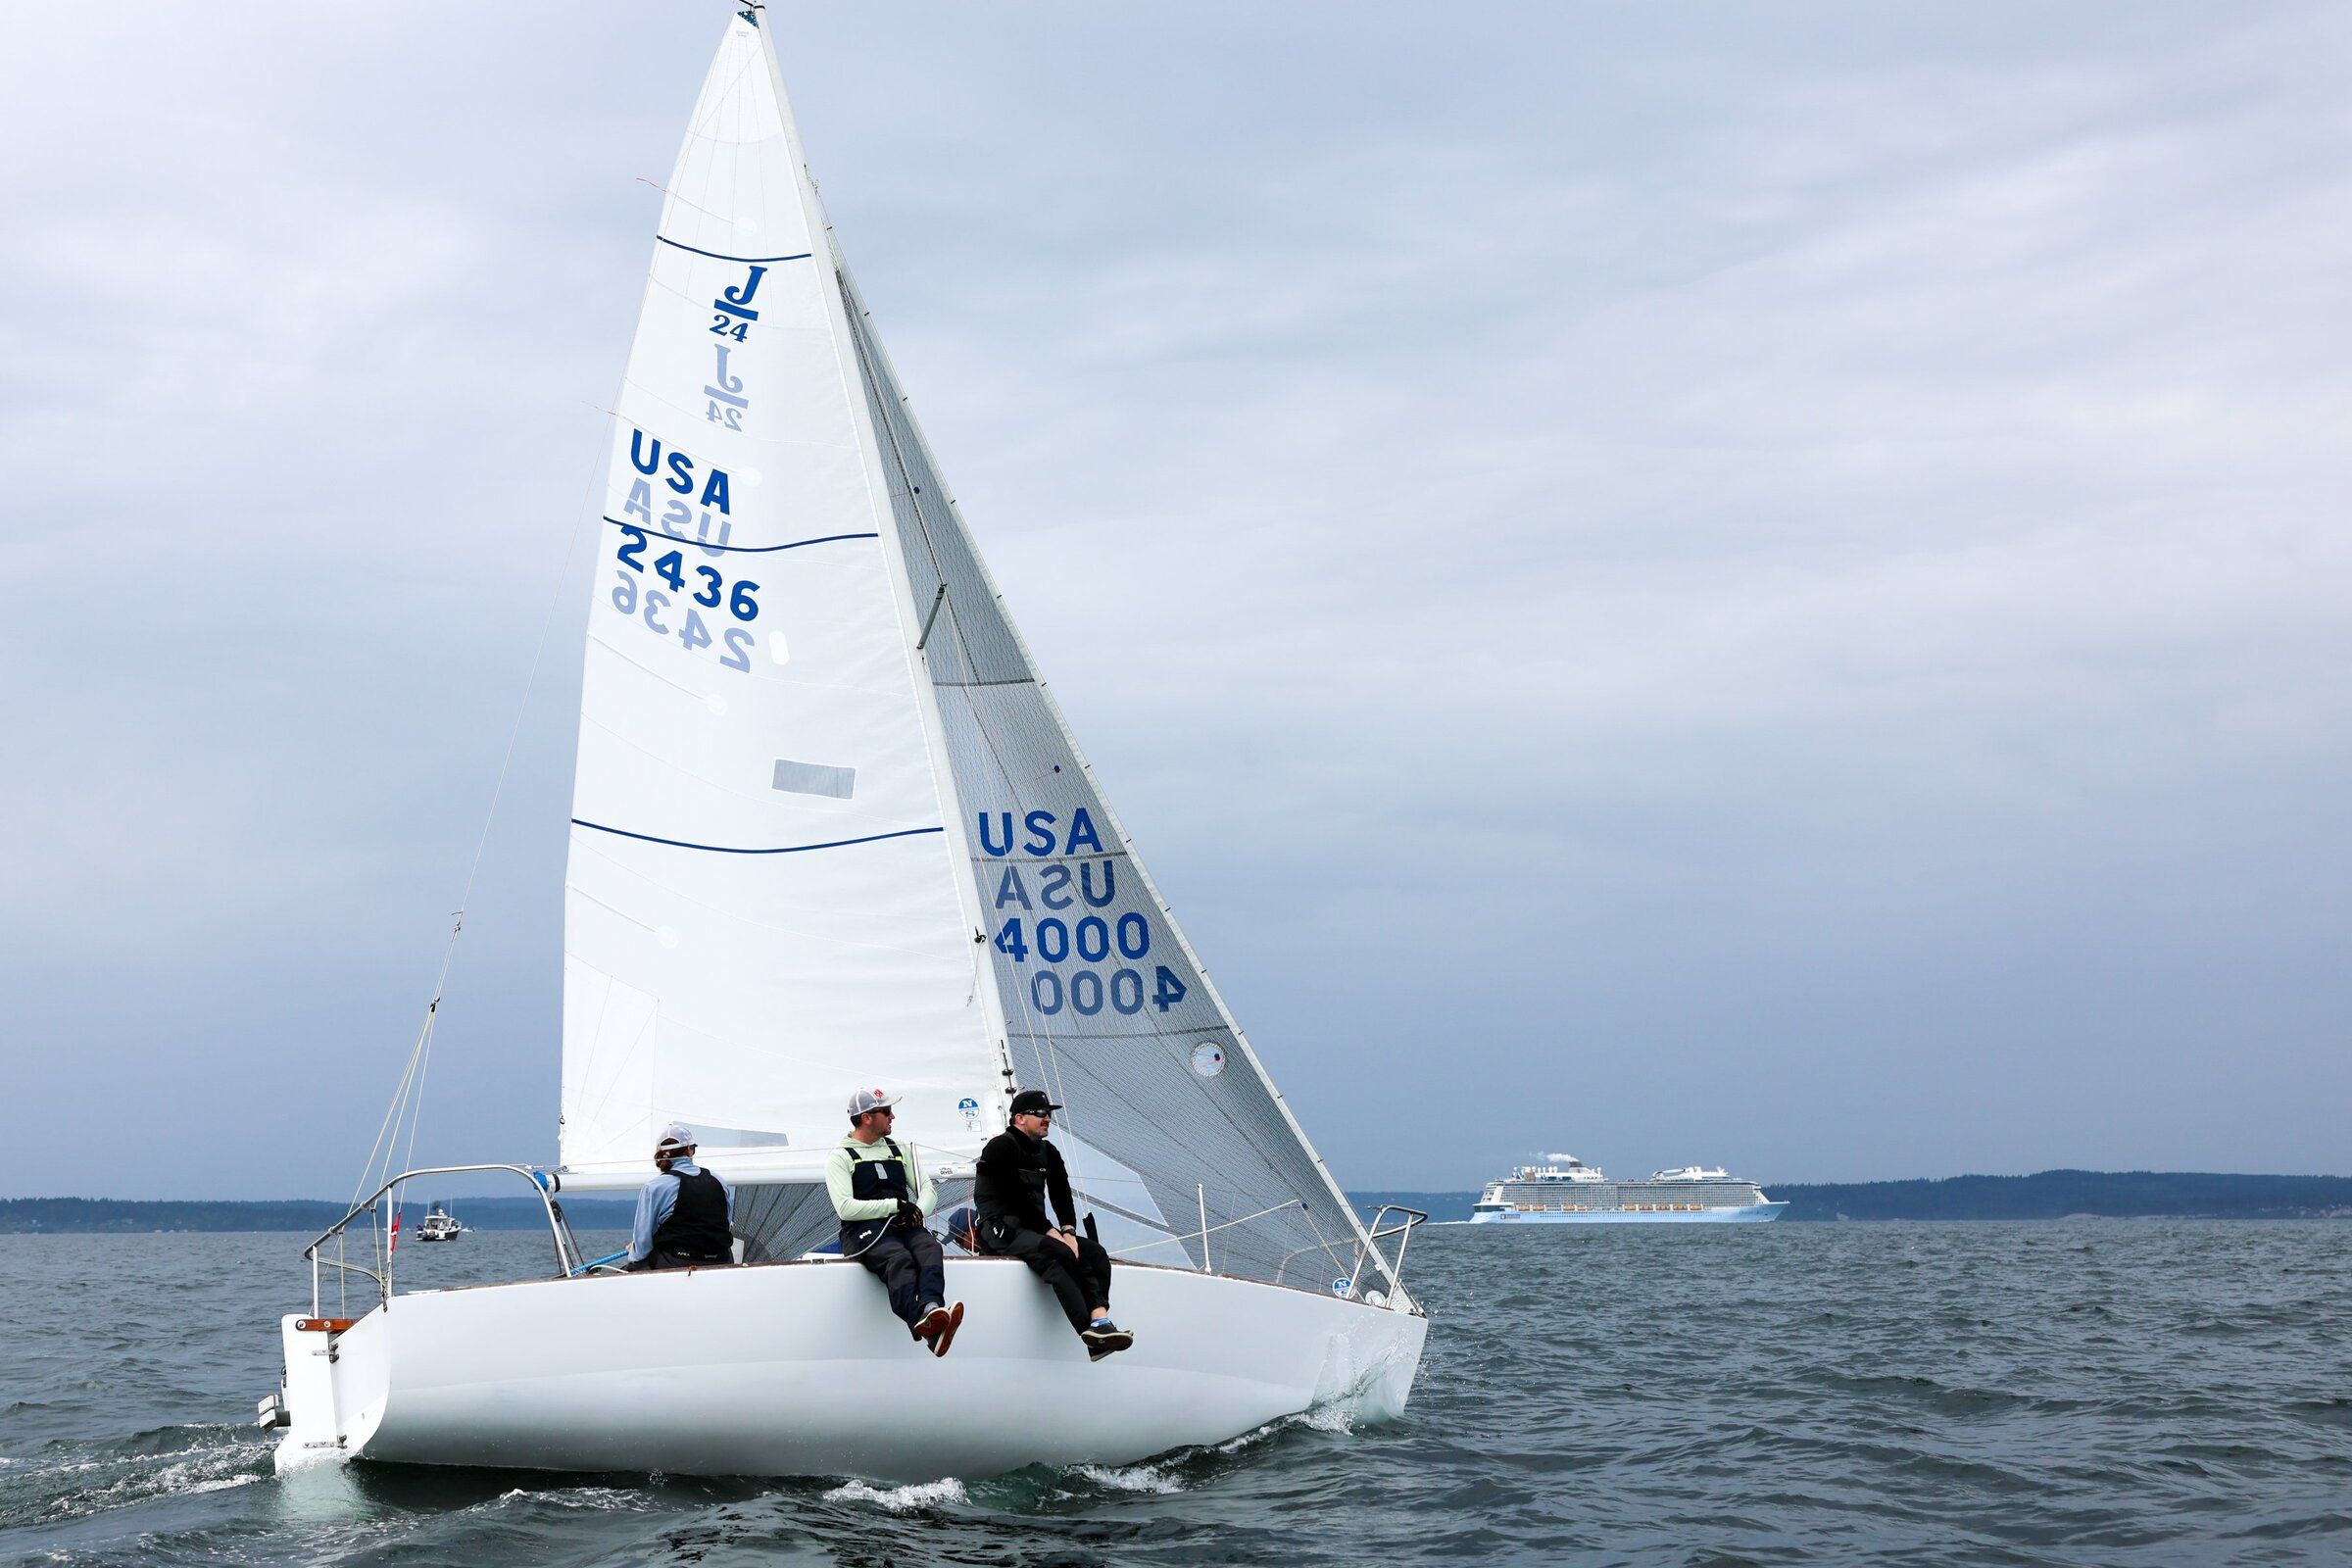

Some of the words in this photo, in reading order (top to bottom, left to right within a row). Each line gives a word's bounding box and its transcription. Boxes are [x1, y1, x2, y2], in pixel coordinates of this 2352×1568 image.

[724, 266, 768, 306] J
[710, 315, 749, 343] 24
[631, 428, 730, 515] USA
[617, 525, 760, 621] 2436
[979, 808, 1103, 857] USA
[994, 912, 1150, 963] 4000
